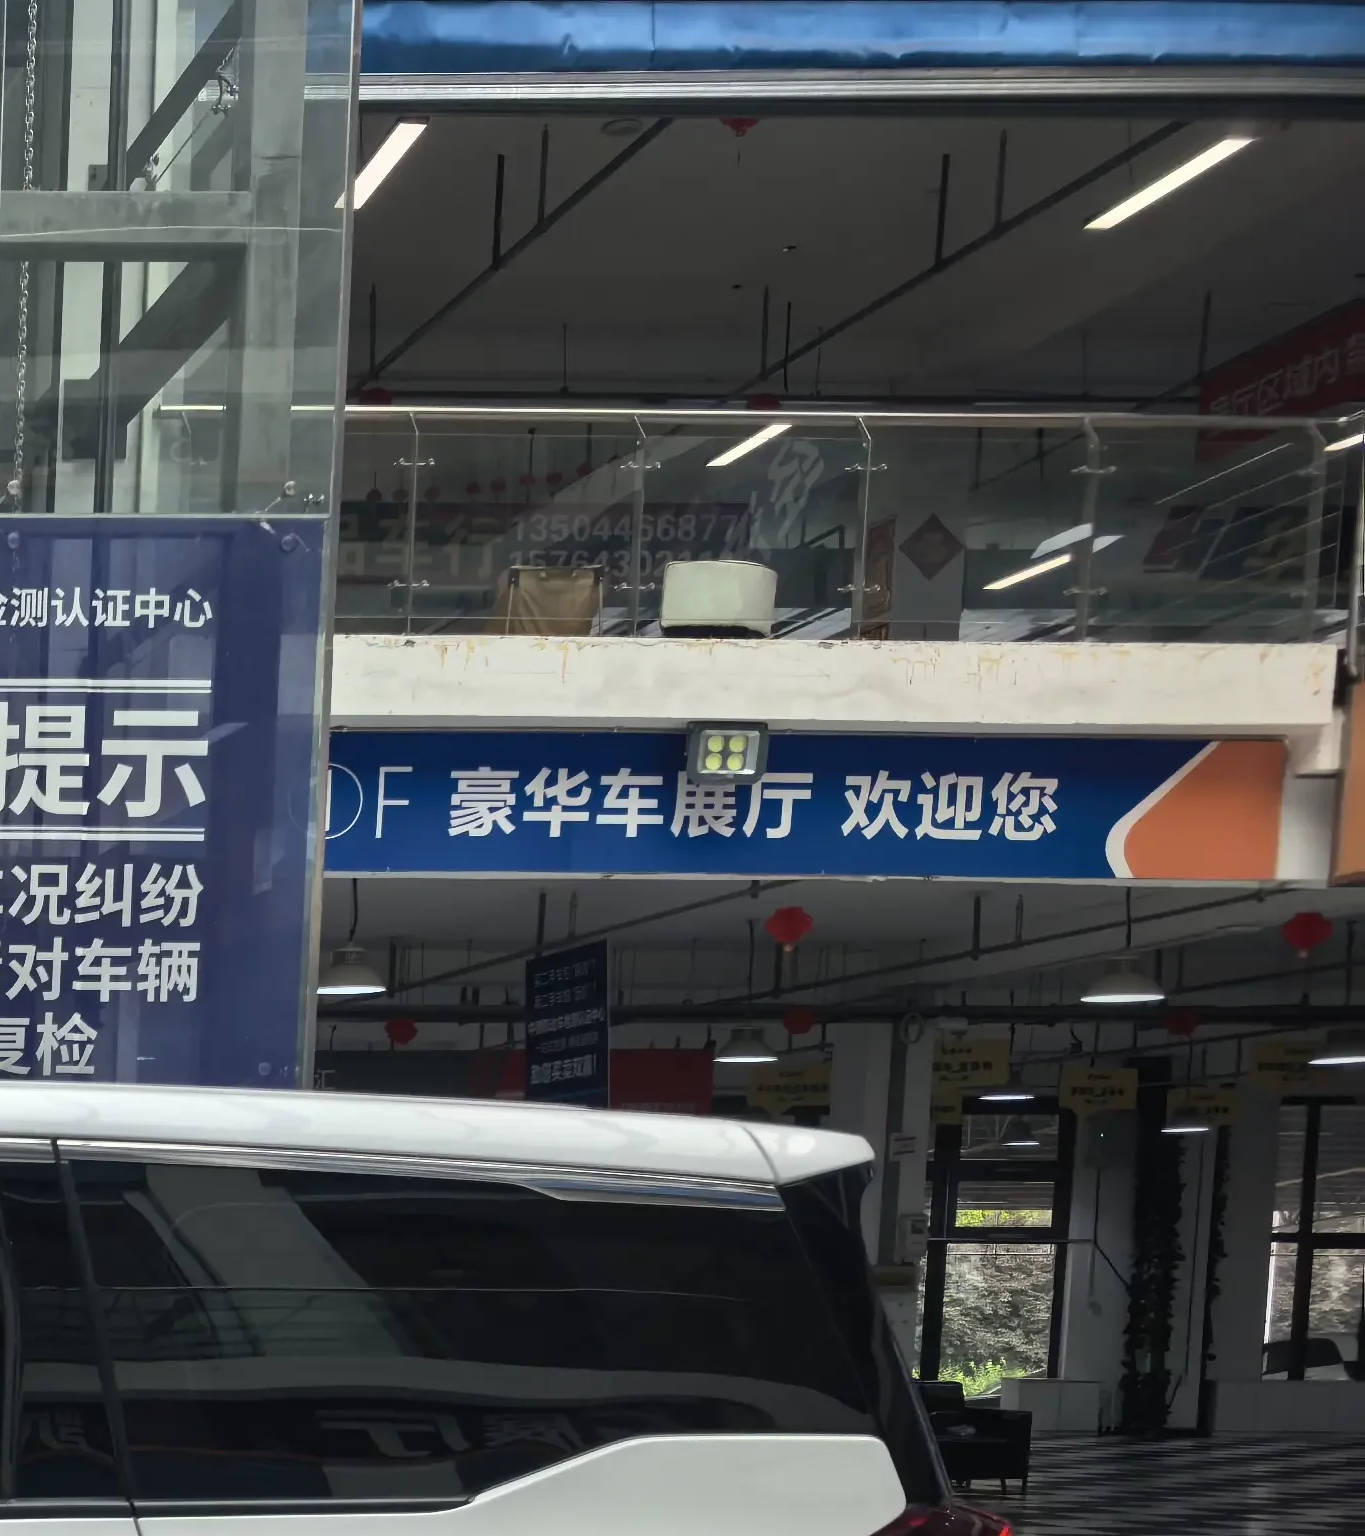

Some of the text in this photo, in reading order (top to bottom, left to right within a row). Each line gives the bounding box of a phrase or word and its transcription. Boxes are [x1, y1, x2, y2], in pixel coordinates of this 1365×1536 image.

[449, 765, 814, 841] 豪华车展厅
[841, 769, 1059, 843] 欢迎您
